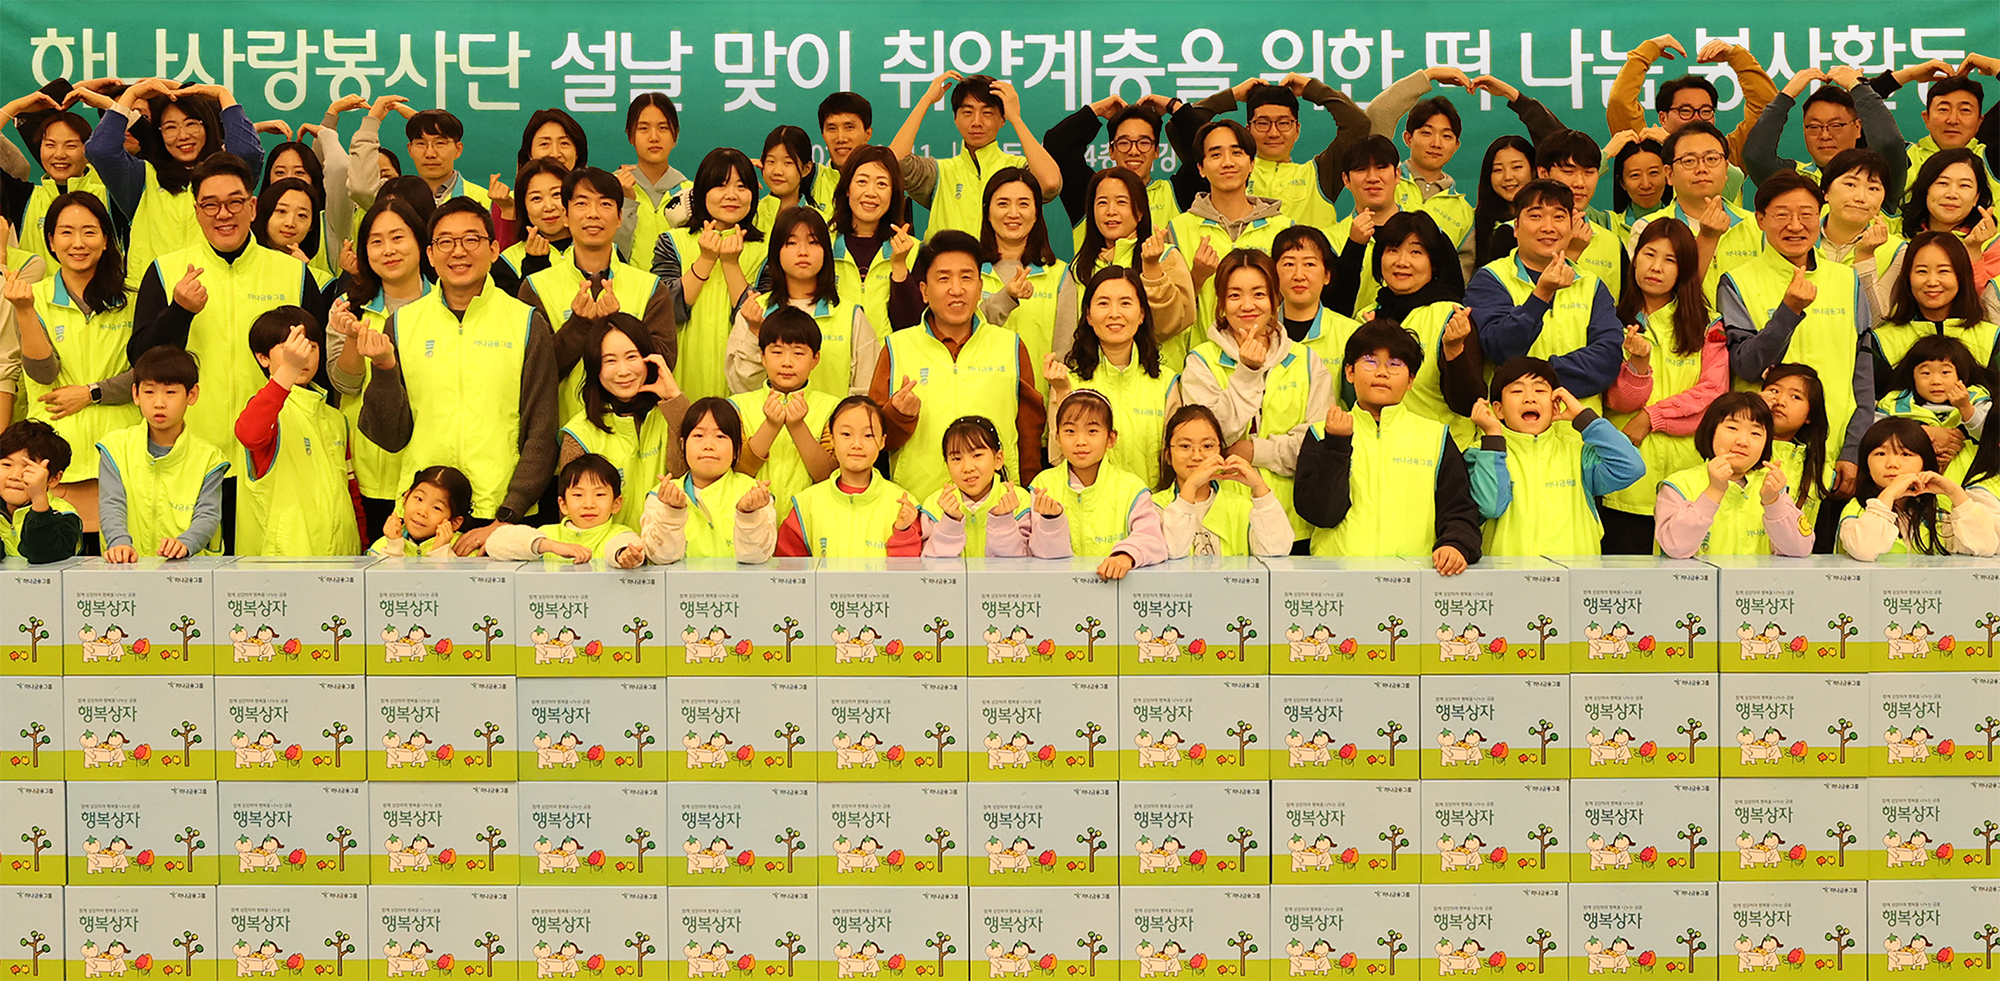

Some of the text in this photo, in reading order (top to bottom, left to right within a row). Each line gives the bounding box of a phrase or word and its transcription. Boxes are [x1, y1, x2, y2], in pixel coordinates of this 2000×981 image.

[31, 24, 1968, 112] 하나사랑봉사단 설날 맞이 취약계층을 위한 떡 나눔 봉사활동
[22, 577, 52, 585] 하나금융그룹
[174, 576, 204, 584] 하나금융그룹
[325, 576, 355, 584] 하나금융그룹
[477, 576, 507, 584] 하나금융그룹
[627, 578, 657, 586] 하나금융그룹
[777, 577, 807, 585] 하나금융그룹
[928, 577, 958, 585] 하나금융그룹
[1231, 577, 1261, 585] 하나금융그룹
[1382, 576, 1412, 584] 하나금융그룹
[1532, 575, 1562, 583] 하나금융그룹
[1680, 574, 1710, 582] 하나금융그룹
[1832, 574, 1862, 582] 하나금융그룹
[77, 599, 137, 618] 행복상자
[228, 599, 288, 618] 행복상자
[380, 599, 440, 618] 행복상자
[529, 601, 589, 620] 행복상자
[680, 600, 740, 619] 행복상자
[830, 600, 890, 619] 행복상자
[982, 600, 1042, 619] 행복상자
[1133, 600, 1193, 619] 행복상자
[1285, 599, 1345, 618] 행복상자
[1435, 598, 1495, 617] 행복상자
[1583, 596, 1643, 615] 행복상자
[1736, 597, 1796, 616] 행복상자
[1883, 596, 1943, 615] 행복상자
[24, 683, 54, 691] 하나금융그룹
[175, 682, 205, 690] 하나금융그룹
[326, 682, 356, 690] 하나금융그룹
[478, 682, 508, 690] 하나금융그룹
[628, 683, 658, 691] 하나금융그룹
[779, 683, 809, 691] 하나금융그룹
[929, 683, 959, 691] 하나금융그룹
[1080, 682, 1110, 690] 하나금융그룹
[1231, 681, 1261, 689] 하나금융그룹
[1381, 681, 1411, 689] 하나금융그룹
[1532, 680, 1562, 688] 하나금융그룹
[1681, 679, 1711, 687] 하나금융그룹
[1832, 679, 1862, 687] 하나금융그룹
[78, 705, 138, 724] 행복상자
[229, 705, 289, 724] 행복상자
[381, 705, 441, 724] 행복상자
[532, 706, 592, 725] 행복상자
[681, 706, 741, 725] 행복상자
[832, 706, 892, 725] 행복상자
[983, 706, 1043, 725] 행복상자
[1134, 704, 1194, 723] 행복상자
[1284, 704, 1344, 723] 행복상자
[1436, 703, 1496, 722] 행복상자
[1585, 702, 1645, 721] 행복상자
[1735, 702, 1795, 721] 행복상자
[1883, 701, 1943, 720] 행복상자
[25, 787, 55, 795] 하나금융그룹
[178, 787, 208, 795] 하나금융그룹
[330, 787, 360, 795] 하나금융그룹
[480, 786, 510, 794] 하나금융그룹
[629, 788, 659, 796] 하나금융그룹
[779, 788, 809, 796] 하나금융그룹
[929, 788, 959, 796] 하나금융그룹
[1081, 788, 1111, 796] 하나금융그룹
[1232, 788, 1262, 796] 하나금융그룹
[1383, 786, 1413, 794] 하나금융그룹
[1532, 785, 1562, 793] 하나금융그룹
[1681, 784, 1711, 792] 하나금융그룹
[1831, 782, 1861, 790] 하나금융그룹
[81, 811, 141, 830] 행복상자
[233, 810, 293, 829] 행복상자
[383, 809, 443, 828] 행복상자
[532, 811, 592, 830] 행복상자
[682, 811, 742, 830] 행복상자
[832, 810, 892, 829] 행복상자
[984, 811, 1044, 830] 행복상자
[1134, 810, 1194, 829] 행복상자
[1286, 809, 1346, 828] 행복상자
[1435, 808, 1495, 827] 행복상자
[1585, 808, 1645, 827] 행복상자
[1735, 806, 1795, 825] 행복상자
[1882, 805, 1942, 824] 행복상자
[24, 892, 54, 900] 하나금융그룹
[177, 892, 207, 900] 하나금융그룹
[329, 892, 359, 900] 하나금융그룹
[479, 892, 509, 900] 하나금융그룹
[629, 892, 659, 900] 하나금융그룹
[780, 892, 810, 900] 하나금융그룹
[930, 892, 960, 900] 하나금융그룹
[1081, 892, 1111, 900] 하나금융그룹
[1232, 892, 1262, 900] 하나금융그룹
[1382, 890, 1412, 898] 하나금융그룹
[1530, 889, 1560, 897] 하나금융그룹
[1681, 889, 1711, 897] 하나금융그룹
[1829, 886, 1859, 894] 하나금융그룹
[79, 915, 139, 934] 행복상자
[231, 914, 291, 933] 행복상자
[382, 914, 442, 933] 행복상자
[532, 915, 592, 934] 행복상자
[682, 915, 742, 934] 행복상자
[833, 915, 893, 934] 행복상자
[984, 915, 1044, 934] 행복상자
[1135, 915, 1195, 934] 행복상자
[1285, 913, 1345, 932] 행복상자
[1434, 913, 1494, 932] 행복상자
[1583, 911, 1643, 930] 행복상자
[1733, 909, 1793, 928] 행복상자
[1882, 909, 1942, 928] 행복상자
